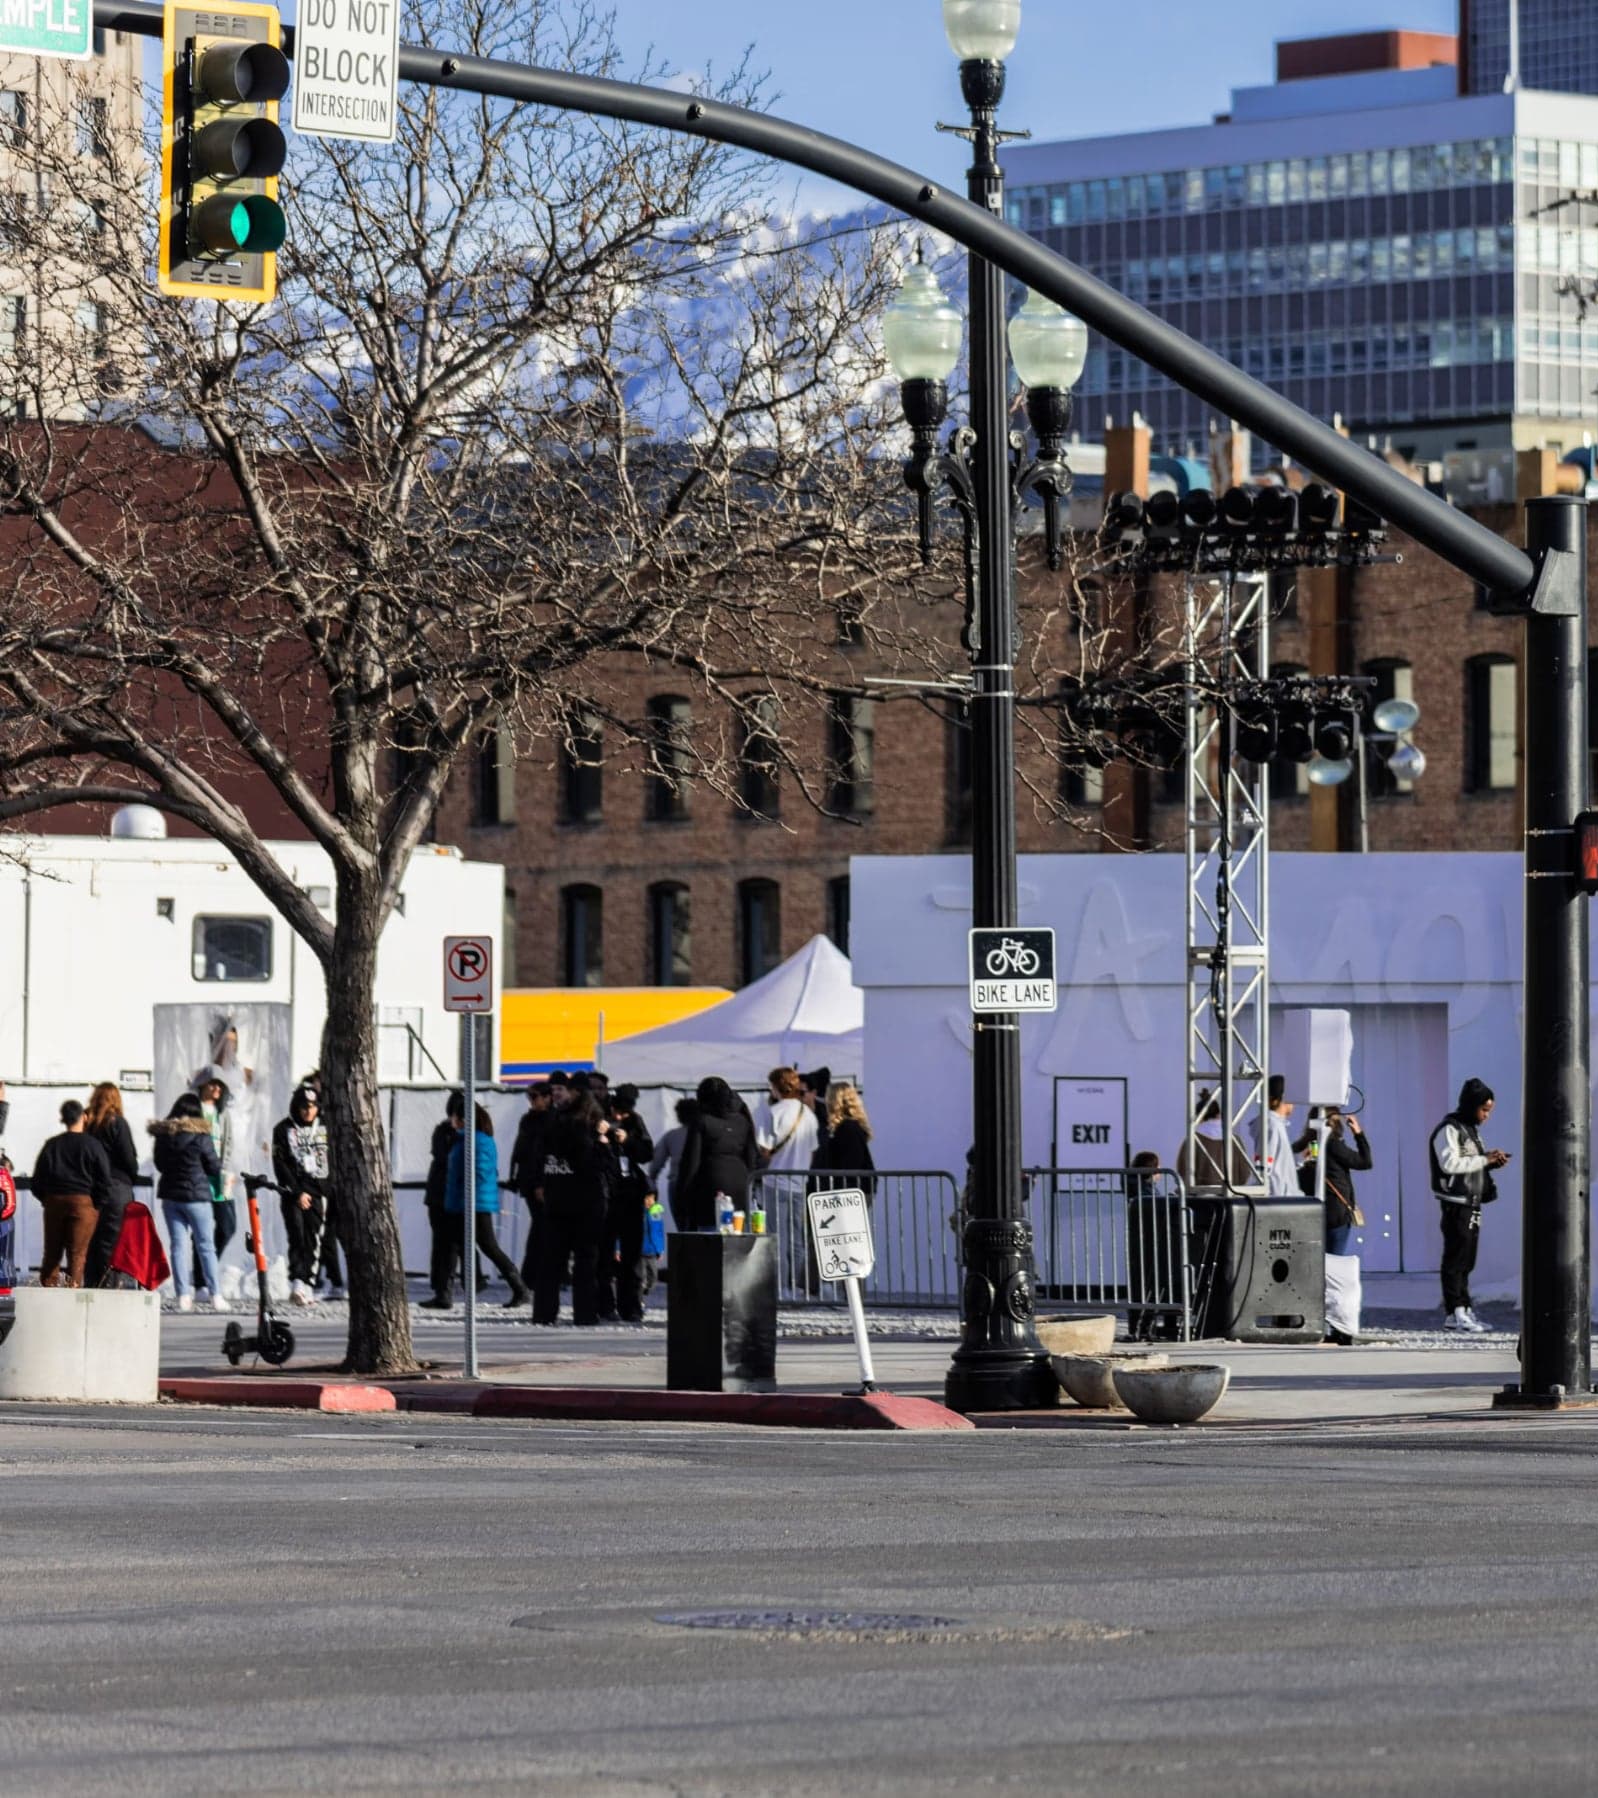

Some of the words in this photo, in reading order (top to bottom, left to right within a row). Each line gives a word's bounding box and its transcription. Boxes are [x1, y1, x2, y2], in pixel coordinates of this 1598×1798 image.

[0, 0, 81, 34] MPLE
[307, 0, 336, 29] DO
[348, 0, 390, 35] NOT
[304, 45, 387, 87] BLOCK
[302, 91, 387, 123] INTERSECTION
[977, 984, 1007, 1003] BIKE
[1015, 983, 1050, 1002] LANE
[1072, 1124, 1111, 1144] EXIT
[815, 1195, 860, 1210] PARKING
[824, 1237, 842, 1247] BIKE
[844, 1235, 864, 1244] LANE
